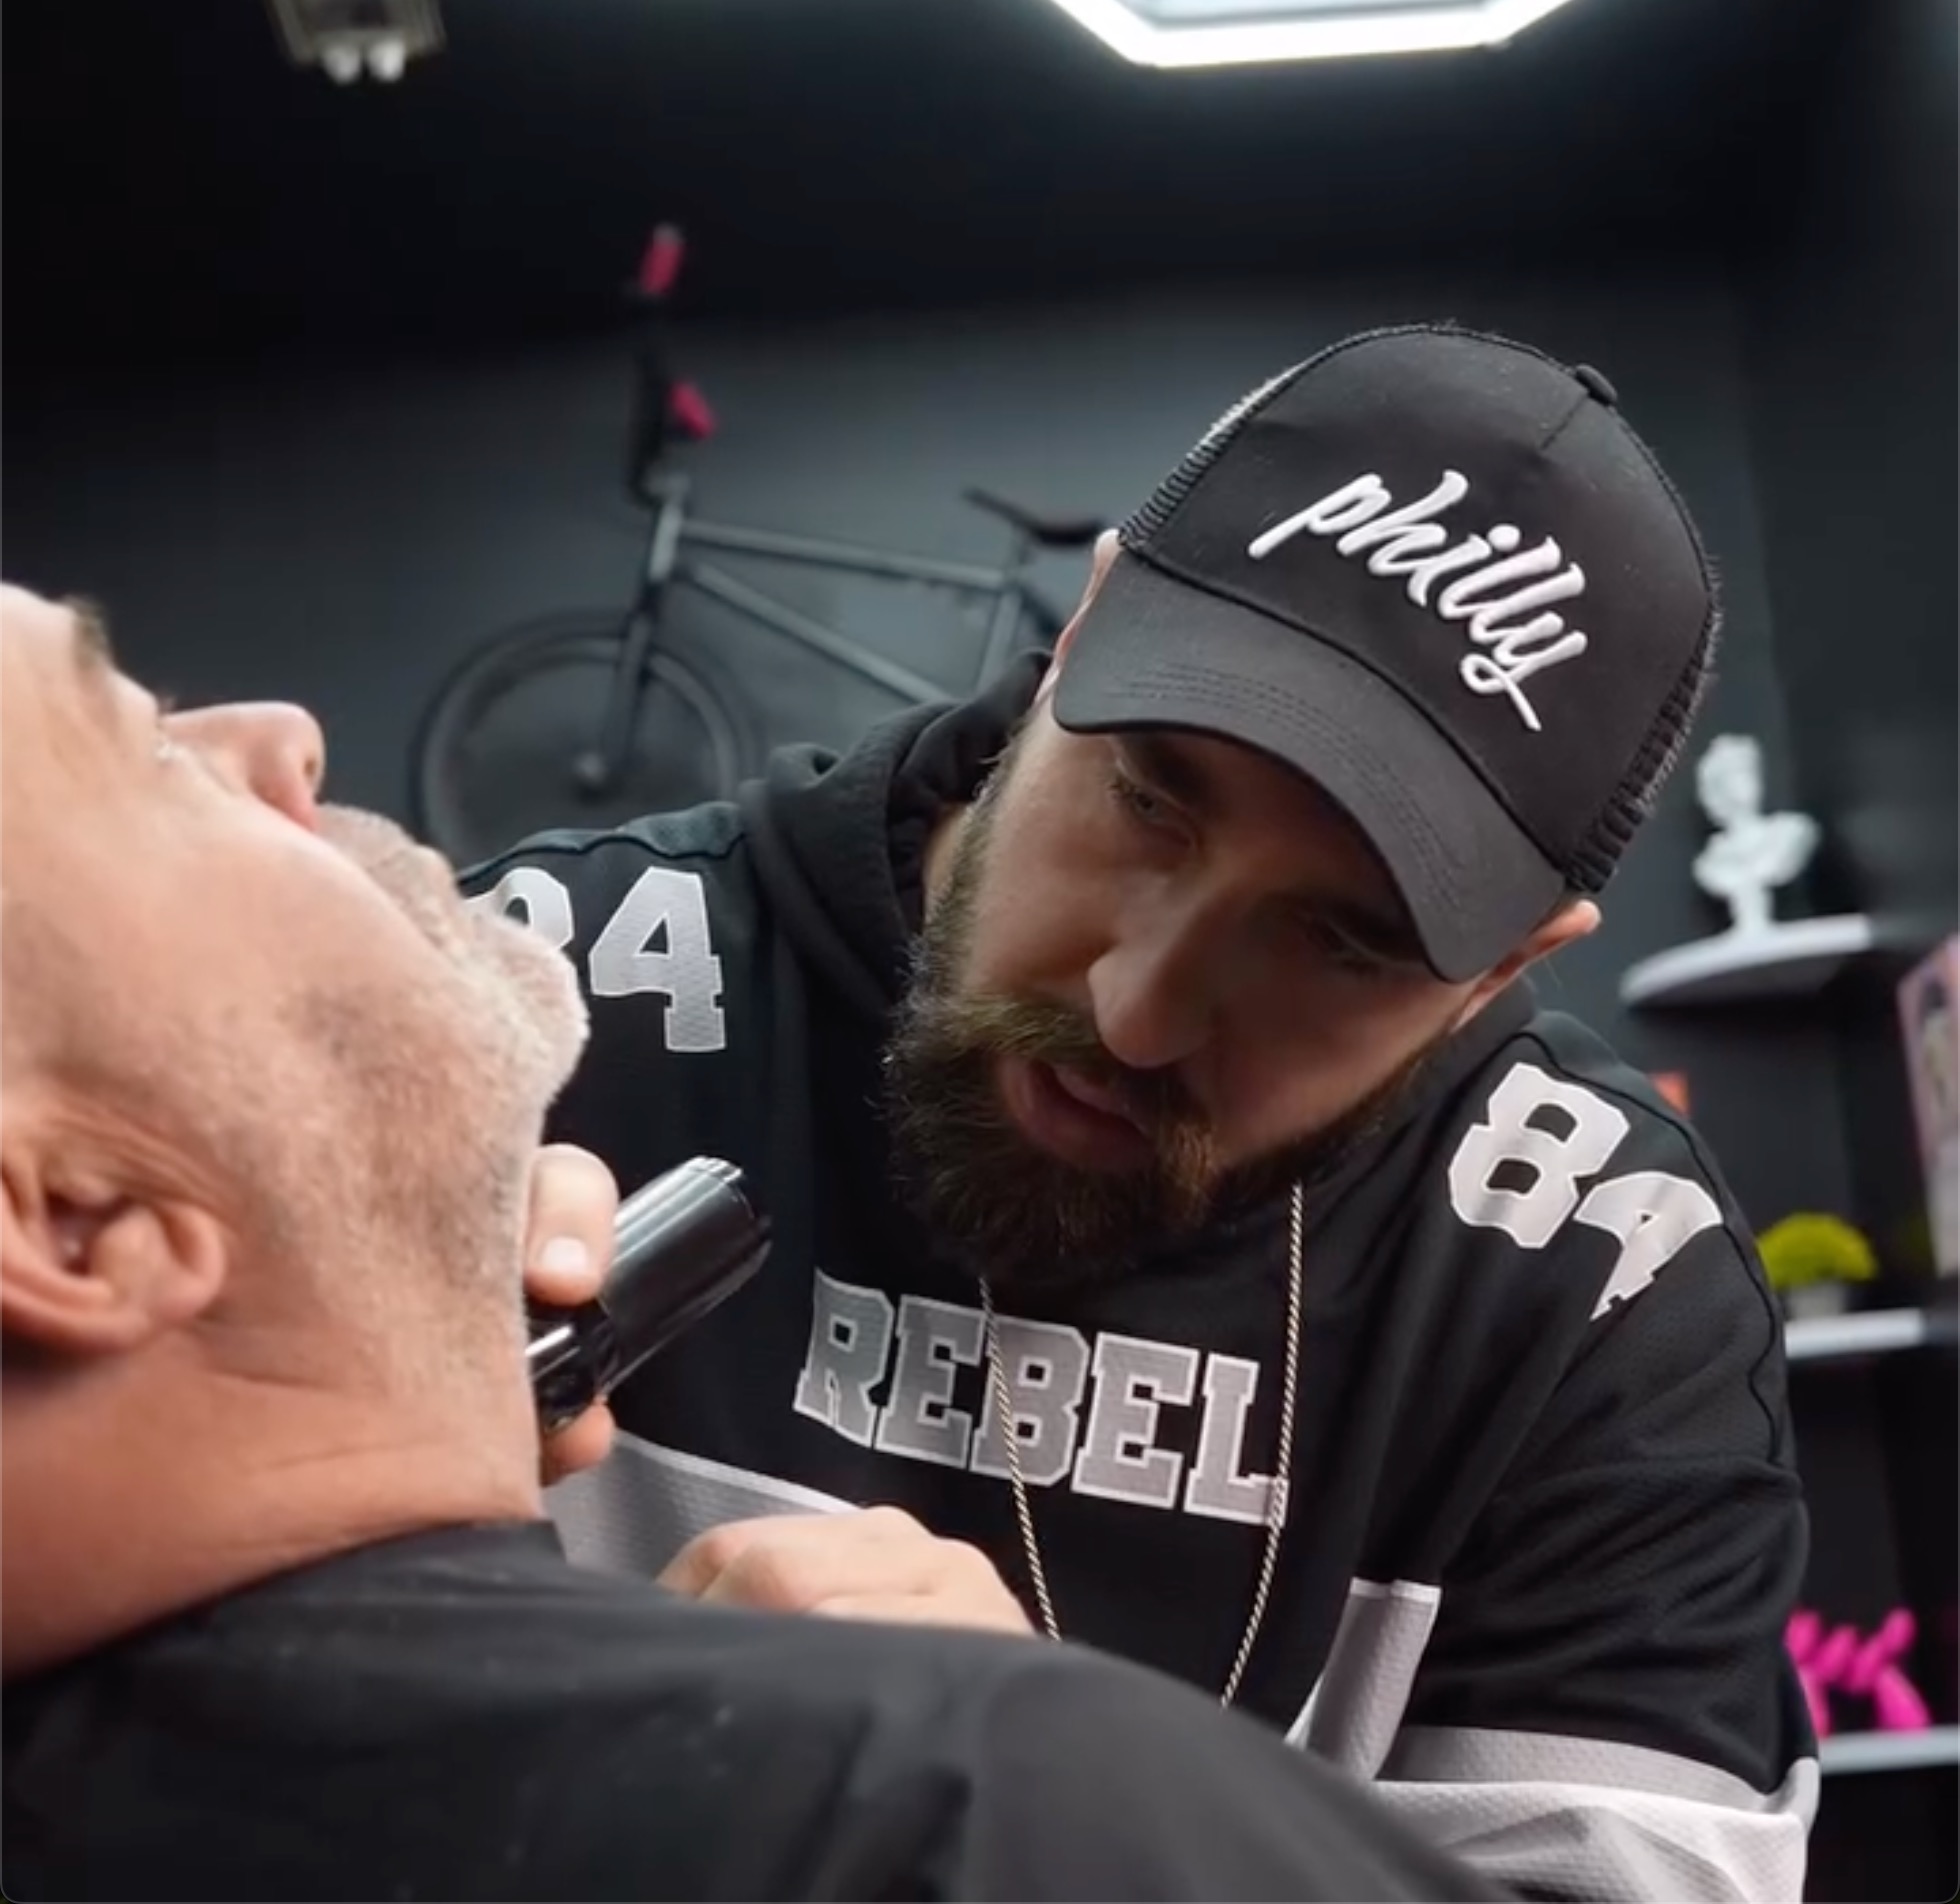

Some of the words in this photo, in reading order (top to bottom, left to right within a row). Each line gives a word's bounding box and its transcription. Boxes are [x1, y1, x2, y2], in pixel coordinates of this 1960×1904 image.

[1248, 469, 1588, 731] philly
[1448, 1061, 1724, 1322] 84
[794, 1267, 1289, 1527] REBEL
